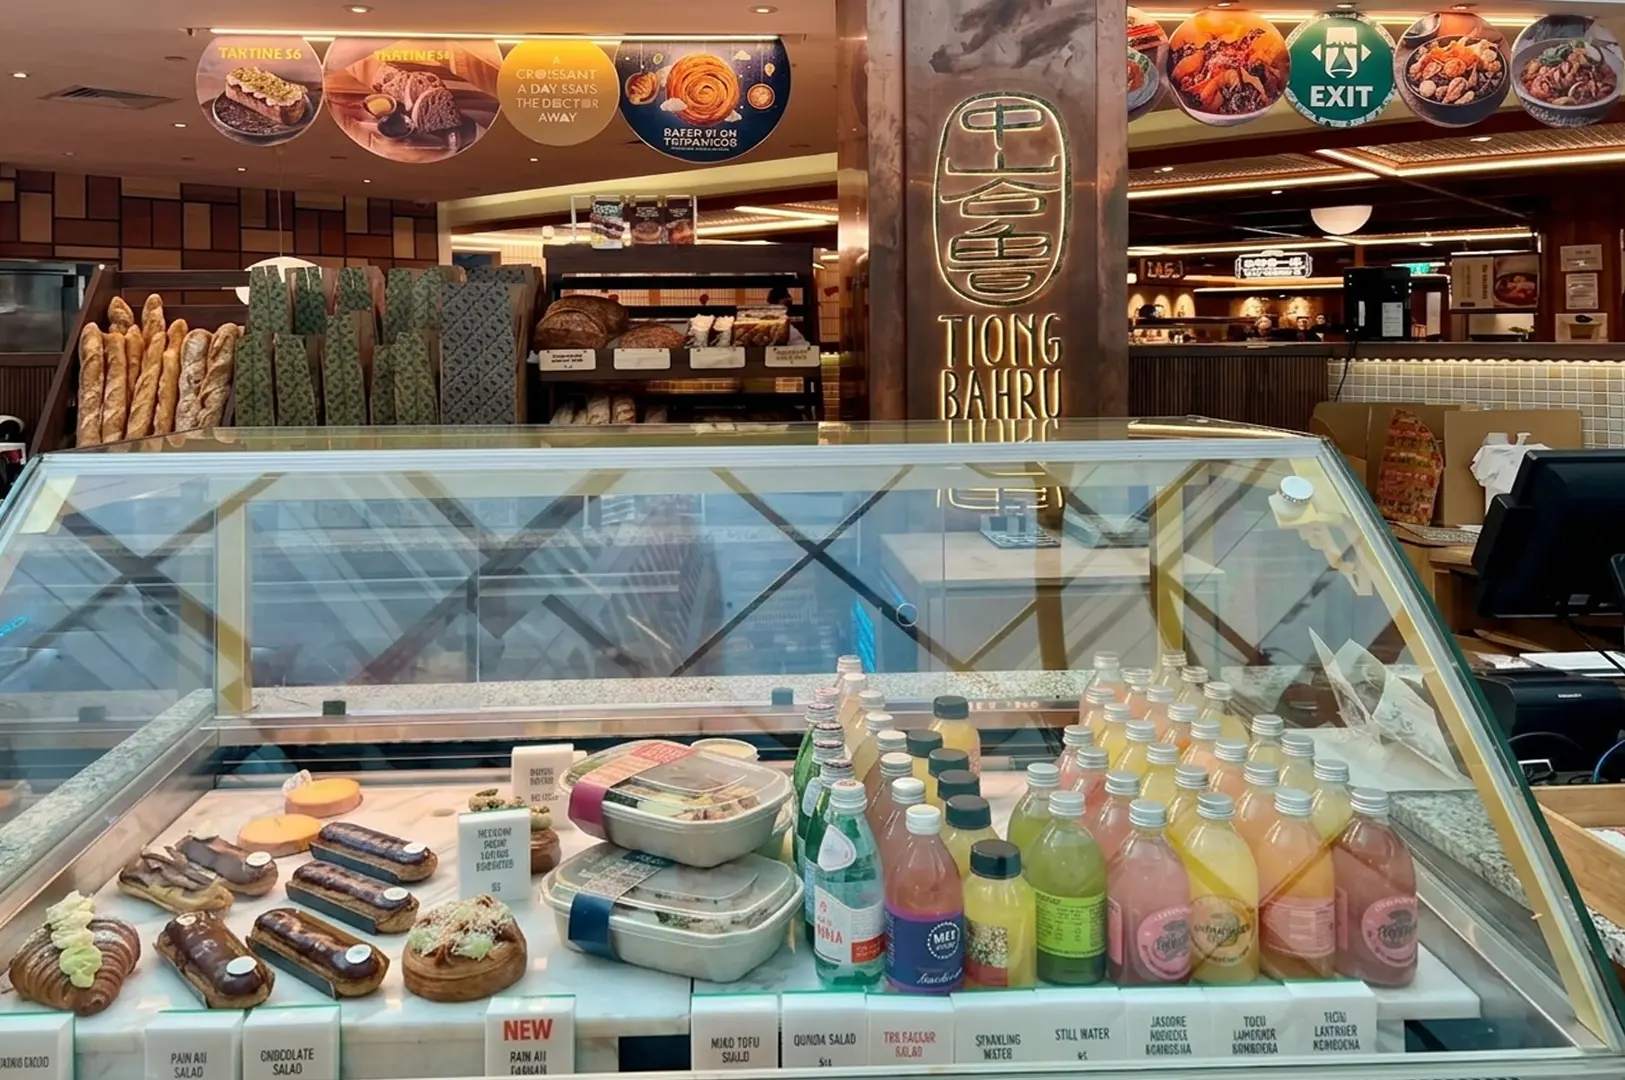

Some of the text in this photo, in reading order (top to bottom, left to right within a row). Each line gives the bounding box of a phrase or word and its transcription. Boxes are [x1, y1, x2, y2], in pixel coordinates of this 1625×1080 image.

[553, 56, 561, 64] A
[517, 84, 527, 95] A
[531, 84, 557, 95] DAY
[1310, 84, 1374, 108] EXIT
[516, 97, 540, 109] THE
[538, 112, 578, 123] AWAY
[938, 313, 1062, 368] TIONG
[940, 368, 1062, 420] BAHRU
[503, 1018, 553, 1041] NEW
[1054, 1028, 1078, 1041] STILL
[737, 1036, 760, 1048] TOFU
[828, 1033, 857, 1046] SALAD
